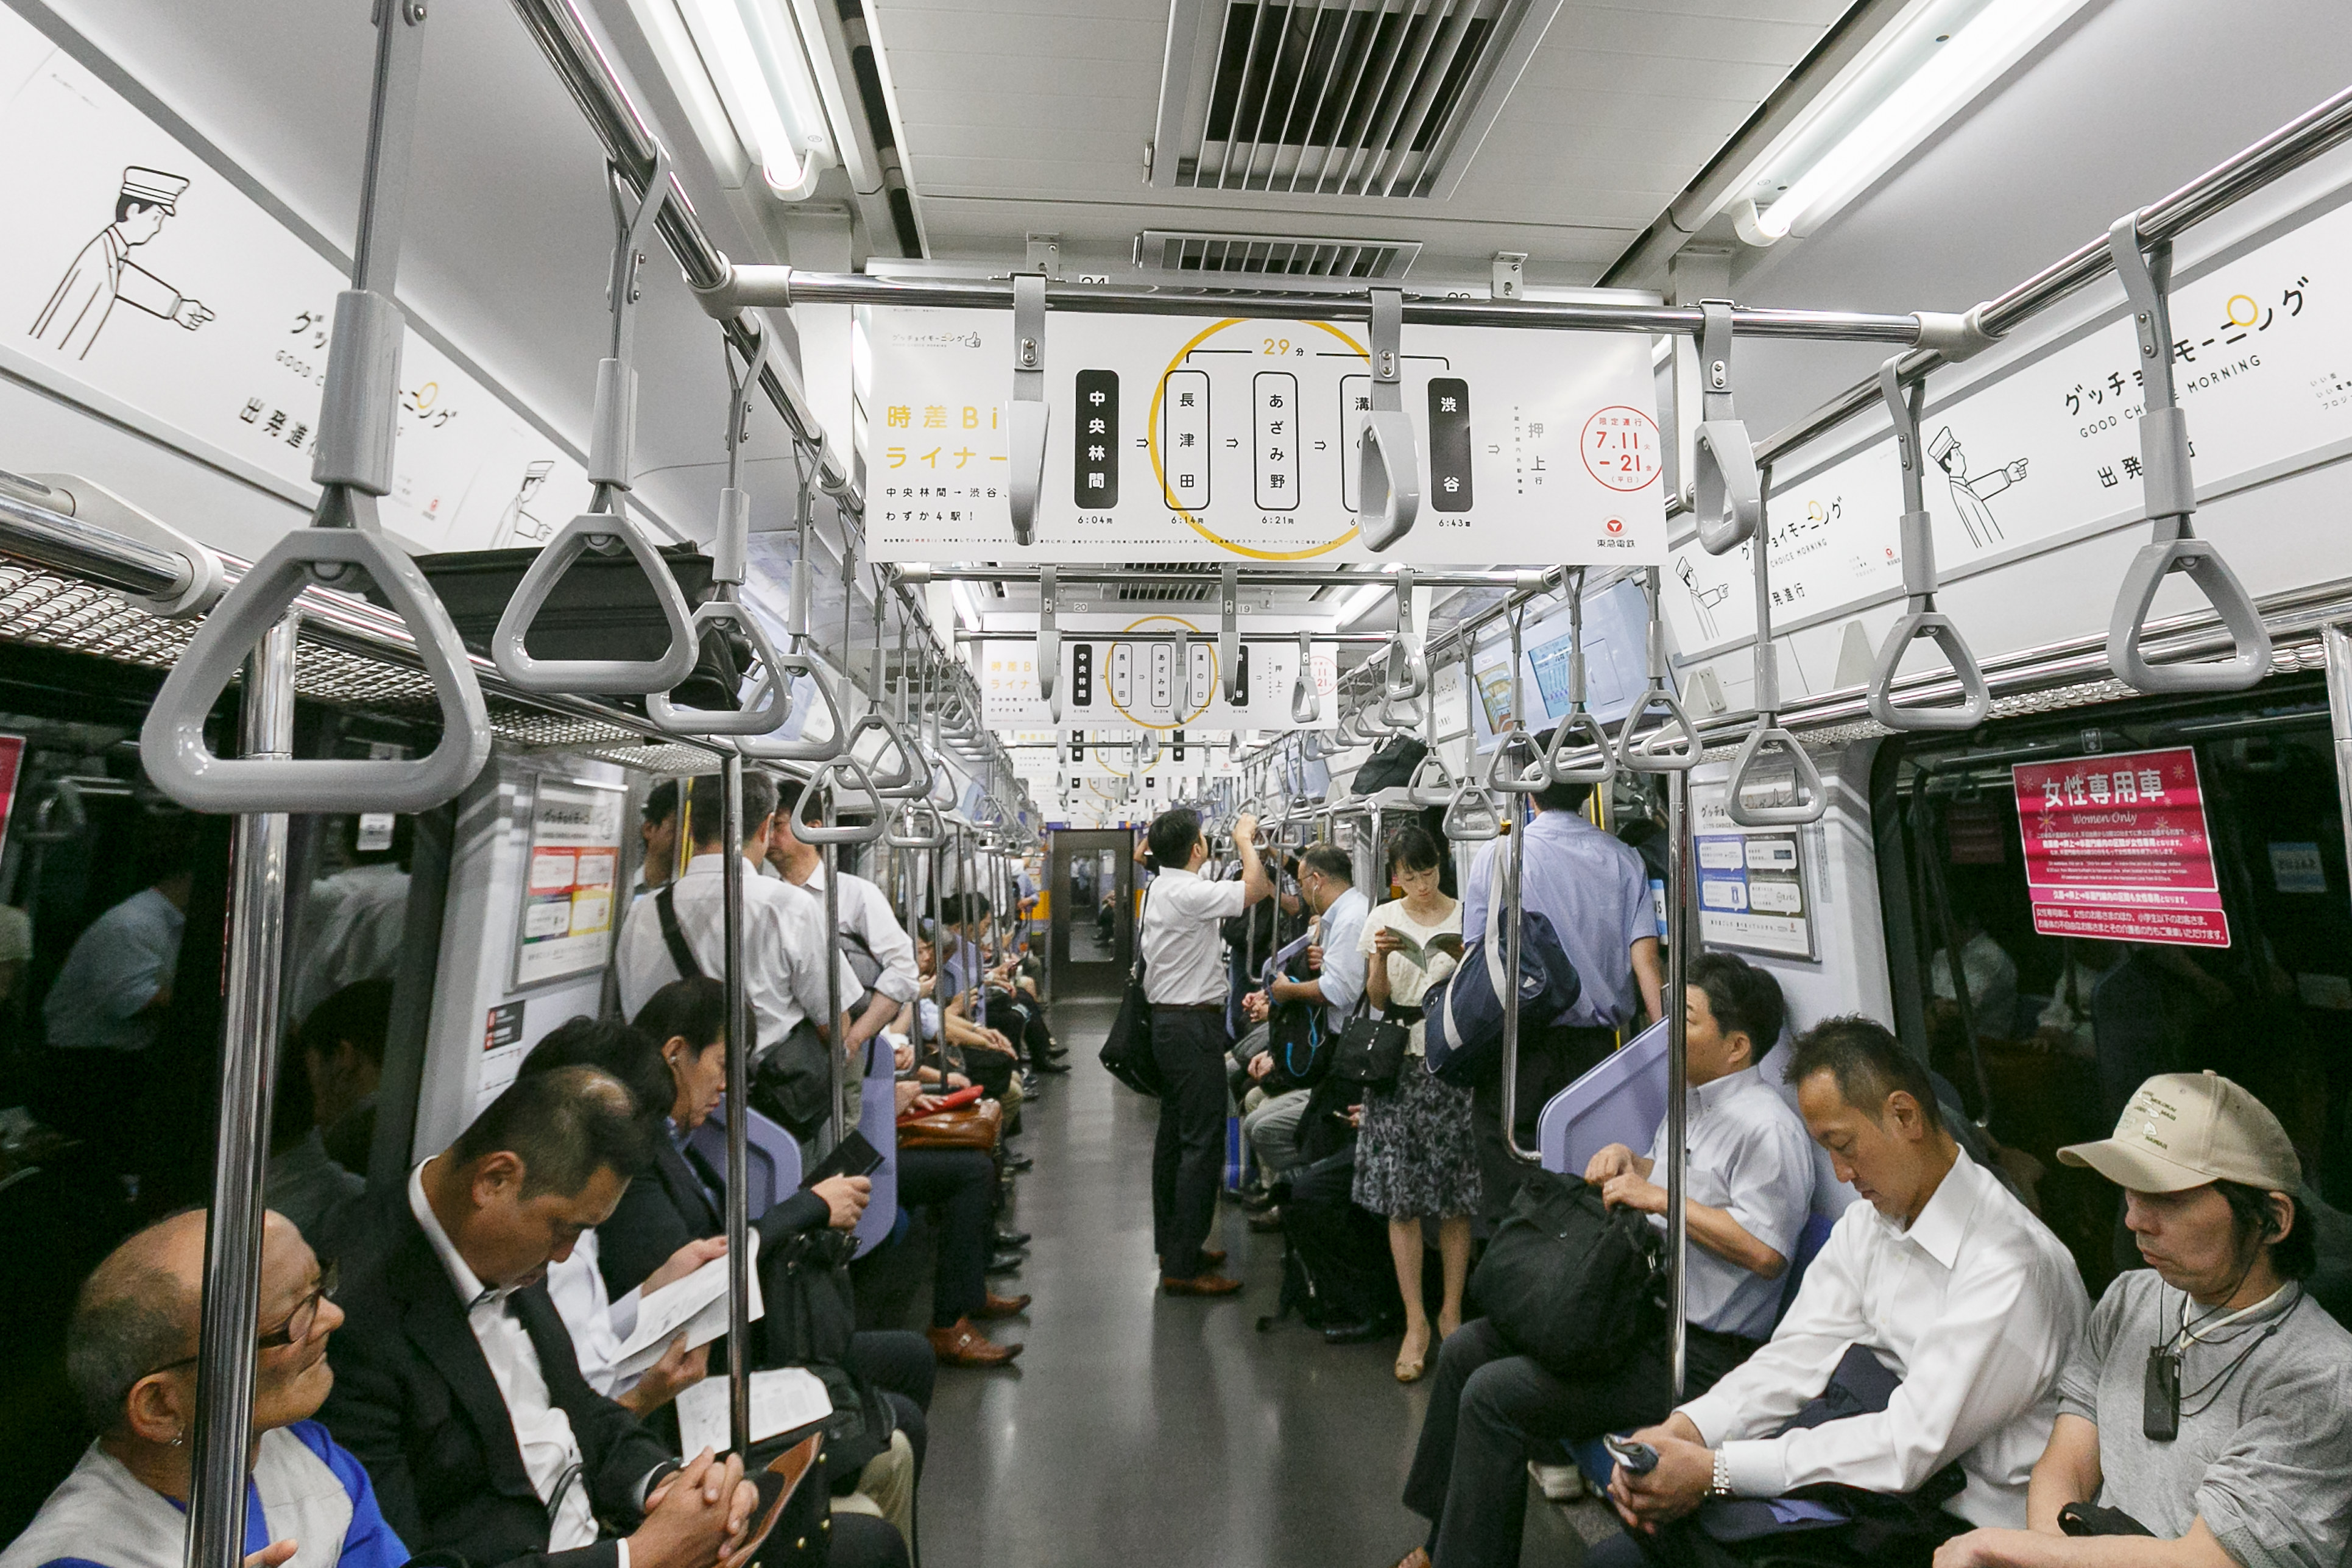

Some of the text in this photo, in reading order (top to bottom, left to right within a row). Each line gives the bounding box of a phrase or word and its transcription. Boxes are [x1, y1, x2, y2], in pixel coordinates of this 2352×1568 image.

[2065, 275, 2311, 417] グッチョモーニング
[275, 349, 313, 379] GOOD
[2080, 415, 2117, 437] GOOD
[2188, 355, 2262, 394] MORNING
[887, 404, 998, 429] 時差Bi
[1598, 417, 1642, 427] 限定運行
[1088, 391, 1106, 490] 中央林間
[1179, 392, 1195, 489] 長津田
[1269, 394, 1285, 490] あざみ野
[1440, 397, 1460, 493] 渋谷
[886, 446, 1008, 469] ライナー
[1597, 539, 1636, 548] 東急電鉄
[1769, 539, 1828, 568] CHOICE MORNING
[1075, 603, 1087, 612] 20
[1769, 582, 1806, 610] 発進行
[2041, 769, 2166, 808] 女性専用車
[2071, 810, 2138, 827] Women Only
